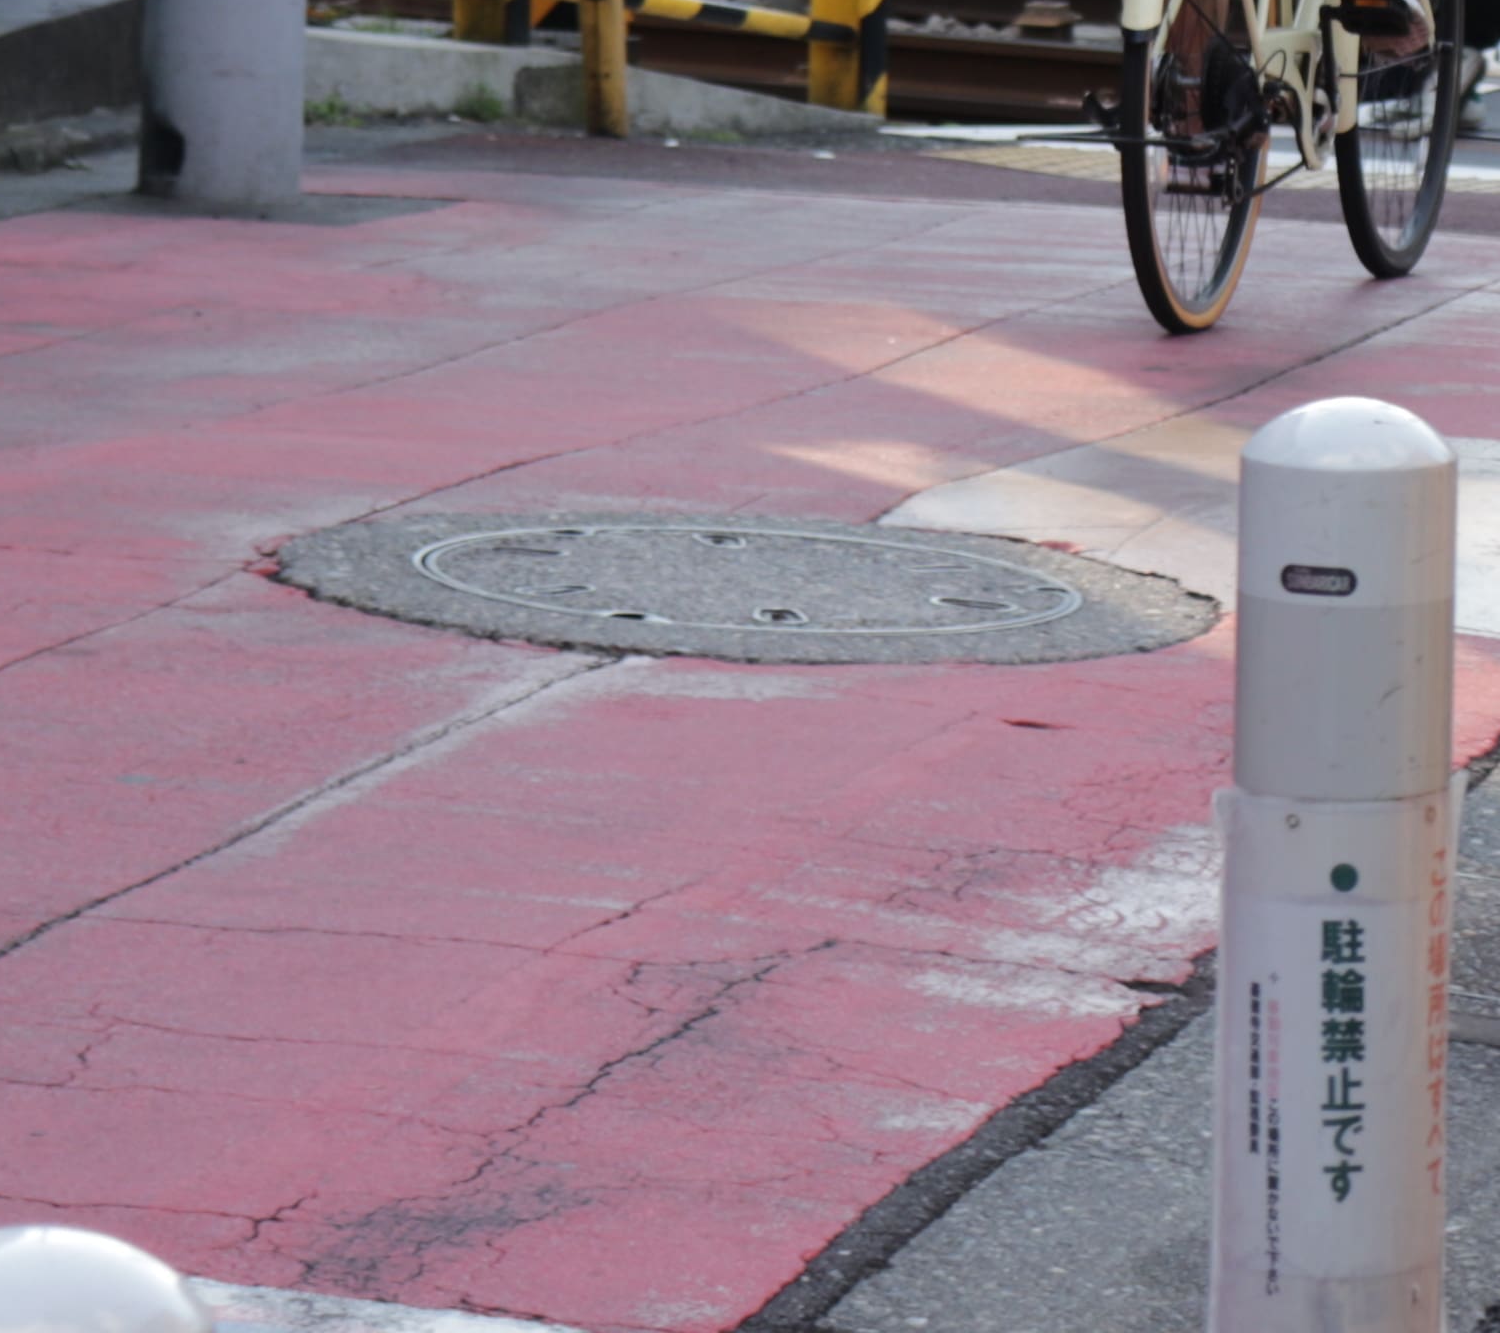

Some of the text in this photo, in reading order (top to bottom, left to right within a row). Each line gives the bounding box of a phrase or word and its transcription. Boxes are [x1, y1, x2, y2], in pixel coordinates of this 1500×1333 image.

[1320, 918, 1366, 1203] 駐輪禁止です
